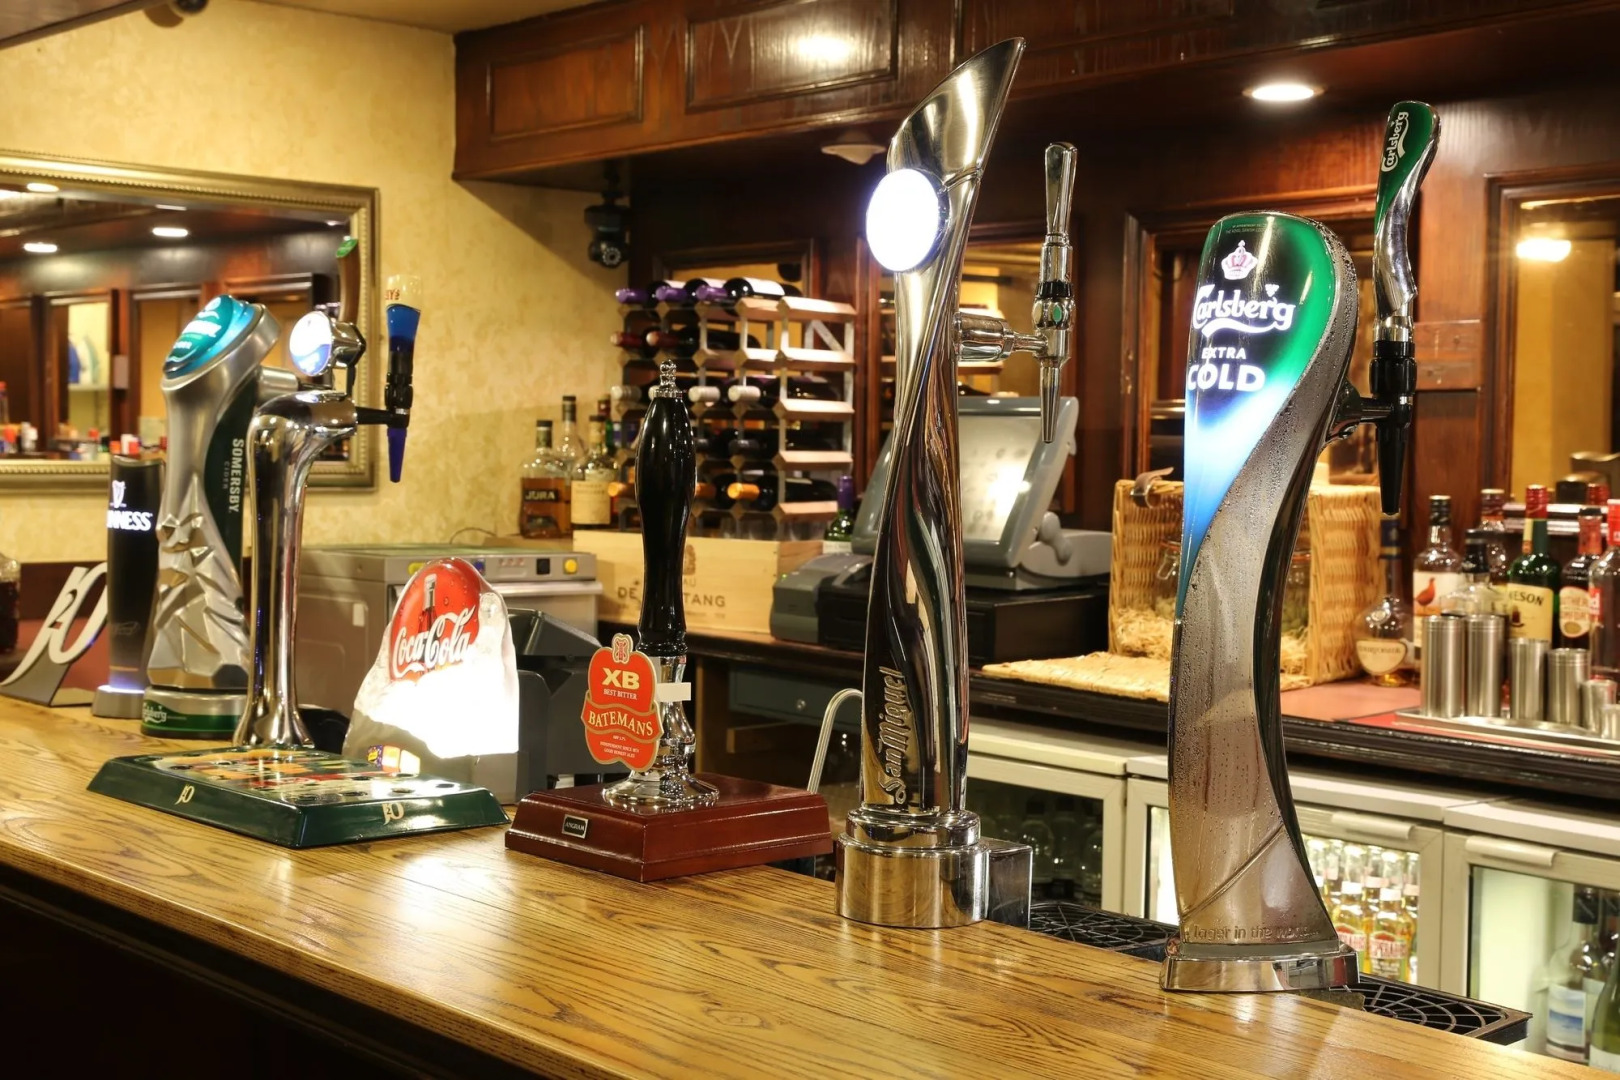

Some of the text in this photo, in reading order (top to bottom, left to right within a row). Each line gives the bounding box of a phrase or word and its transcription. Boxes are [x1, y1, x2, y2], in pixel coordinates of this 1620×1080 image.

[1381, 112, 1409, 172] Carlsberg
[1193, 284, 1296, 337] Carlsberg
[1202, 347, 1247, 360] EXTRA
[1188, 363, 1265, 392] COLD
[222, 461, 230, 489] CIDER
[229, 439, 245, 511] SOMERSBY
[525, 490, 556, 500] JURA
[106, 510, 151, 531] NNESS
[683, 592, 726, 608] TANG
[602, 668, 640, 690] XB
[603, 688, 637, 700] BEST BITTER
[588, 710, 653, 737] BATEMANS
[878, 666, 912, 804] San Miguel
[1195, 924, 1229, 941] lager
[1235, 925, 1247, 939] in
[1252, 926, 1273, 939] the
